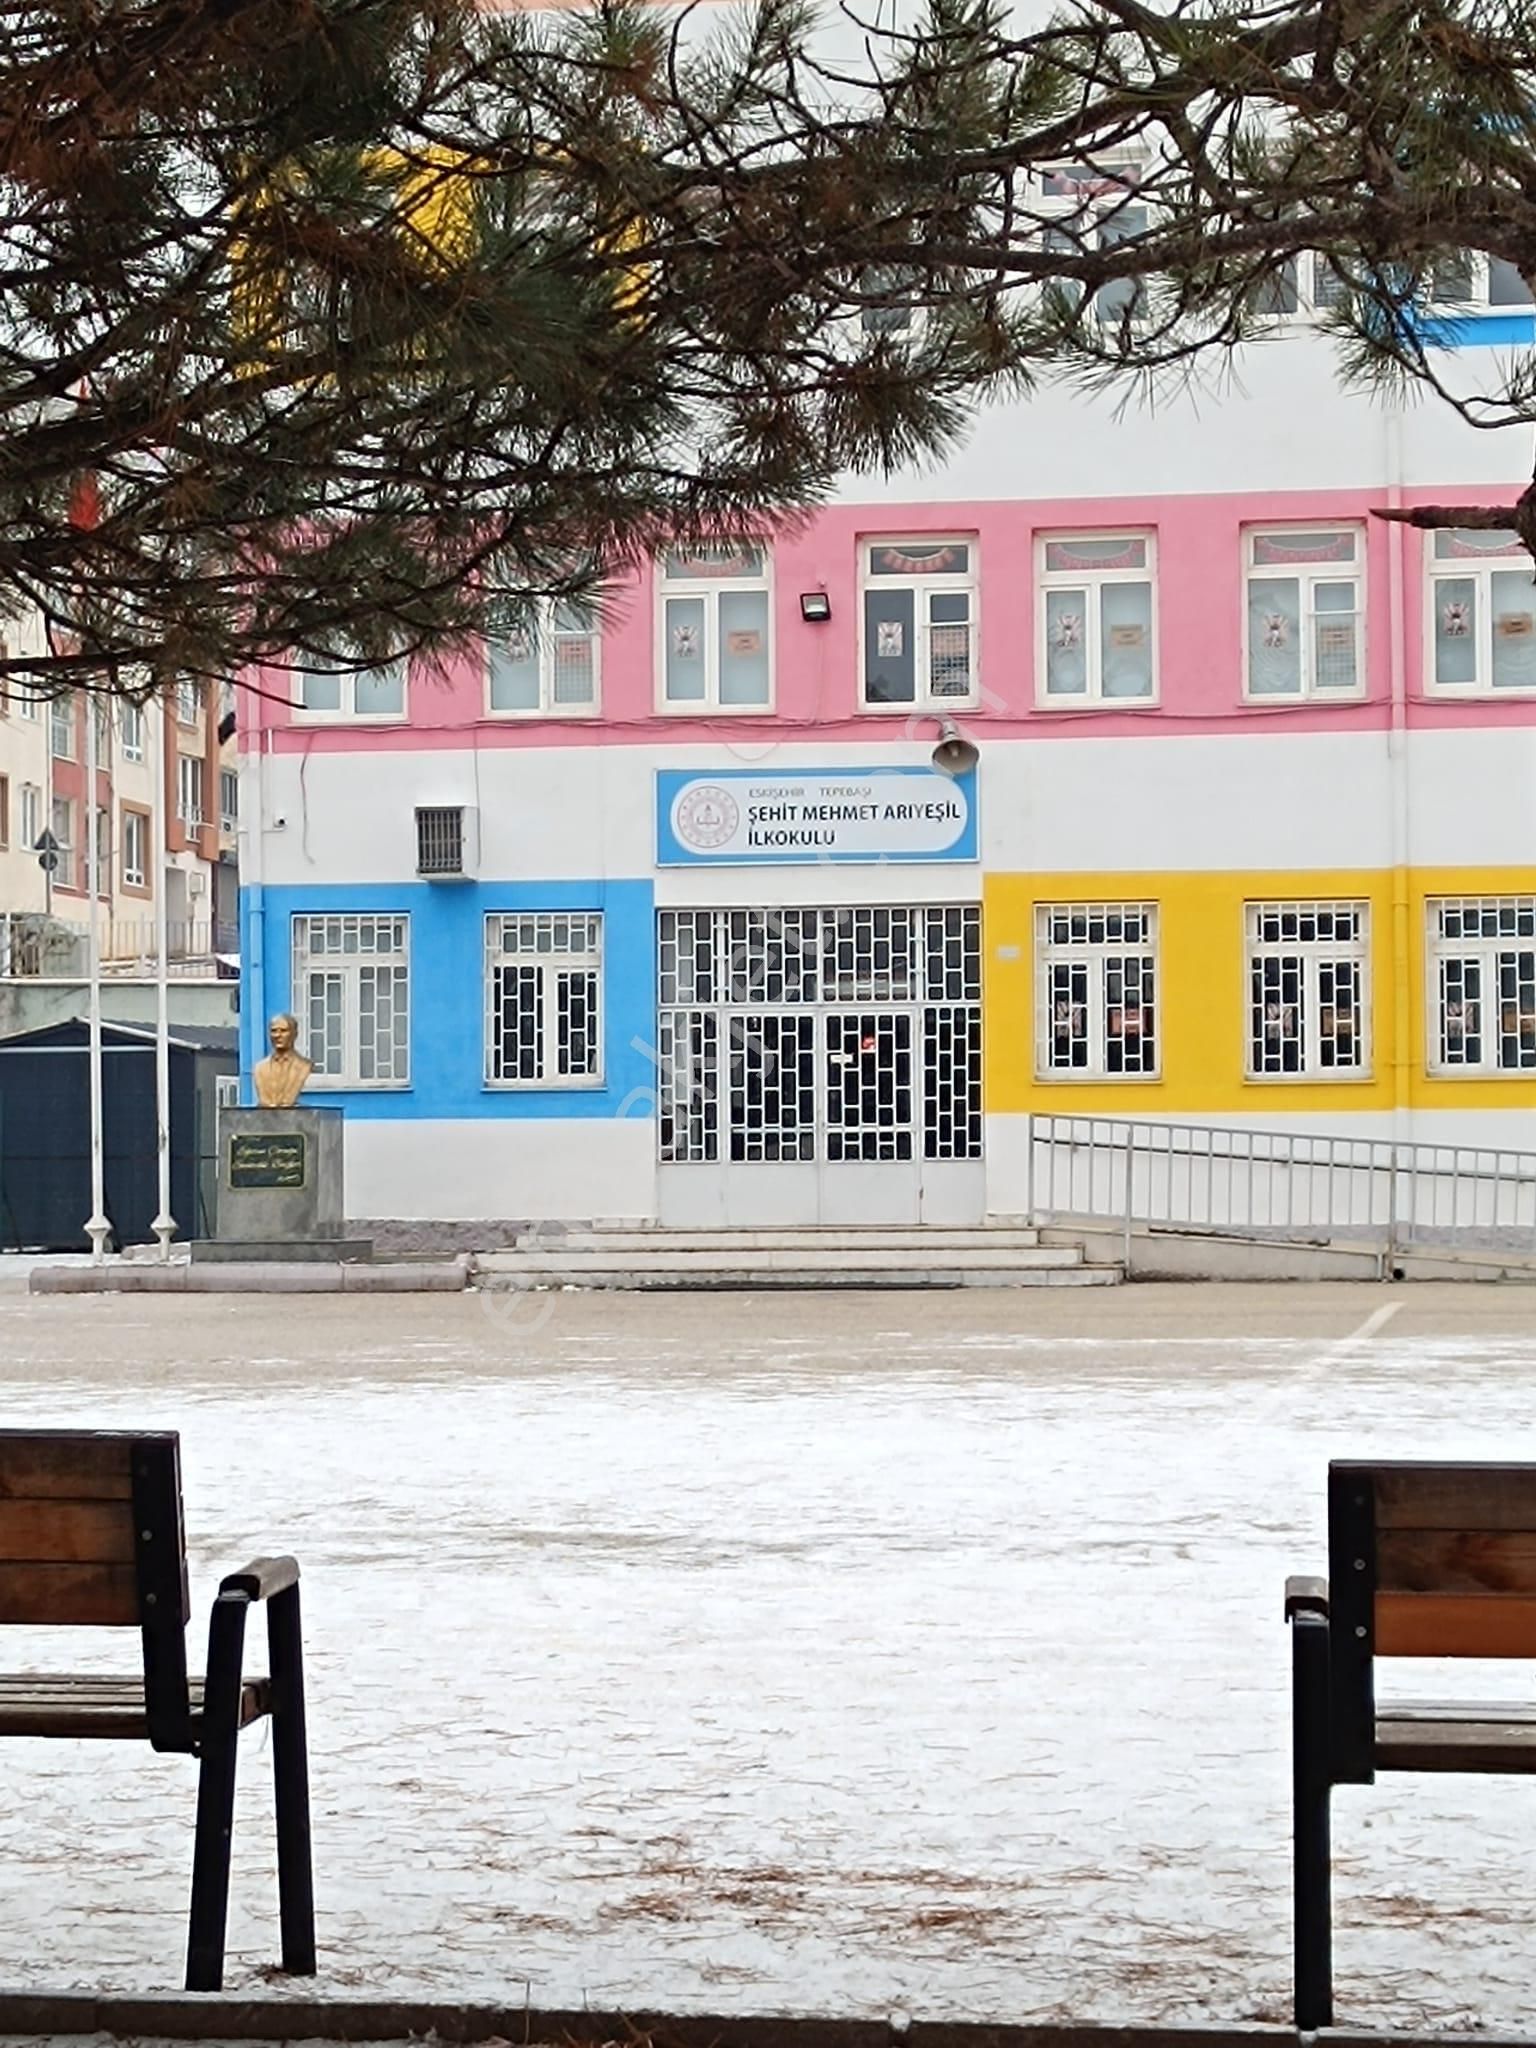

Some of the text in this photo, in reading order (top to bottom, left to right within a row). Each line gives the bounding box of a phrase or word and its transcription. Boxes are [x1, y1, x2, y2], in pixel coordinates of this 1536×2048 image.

[748, 801, 961, 824] ŞEHİT MEHMET ARIYEŞİL
[748, 823, 836, 846] İLKOKULU
